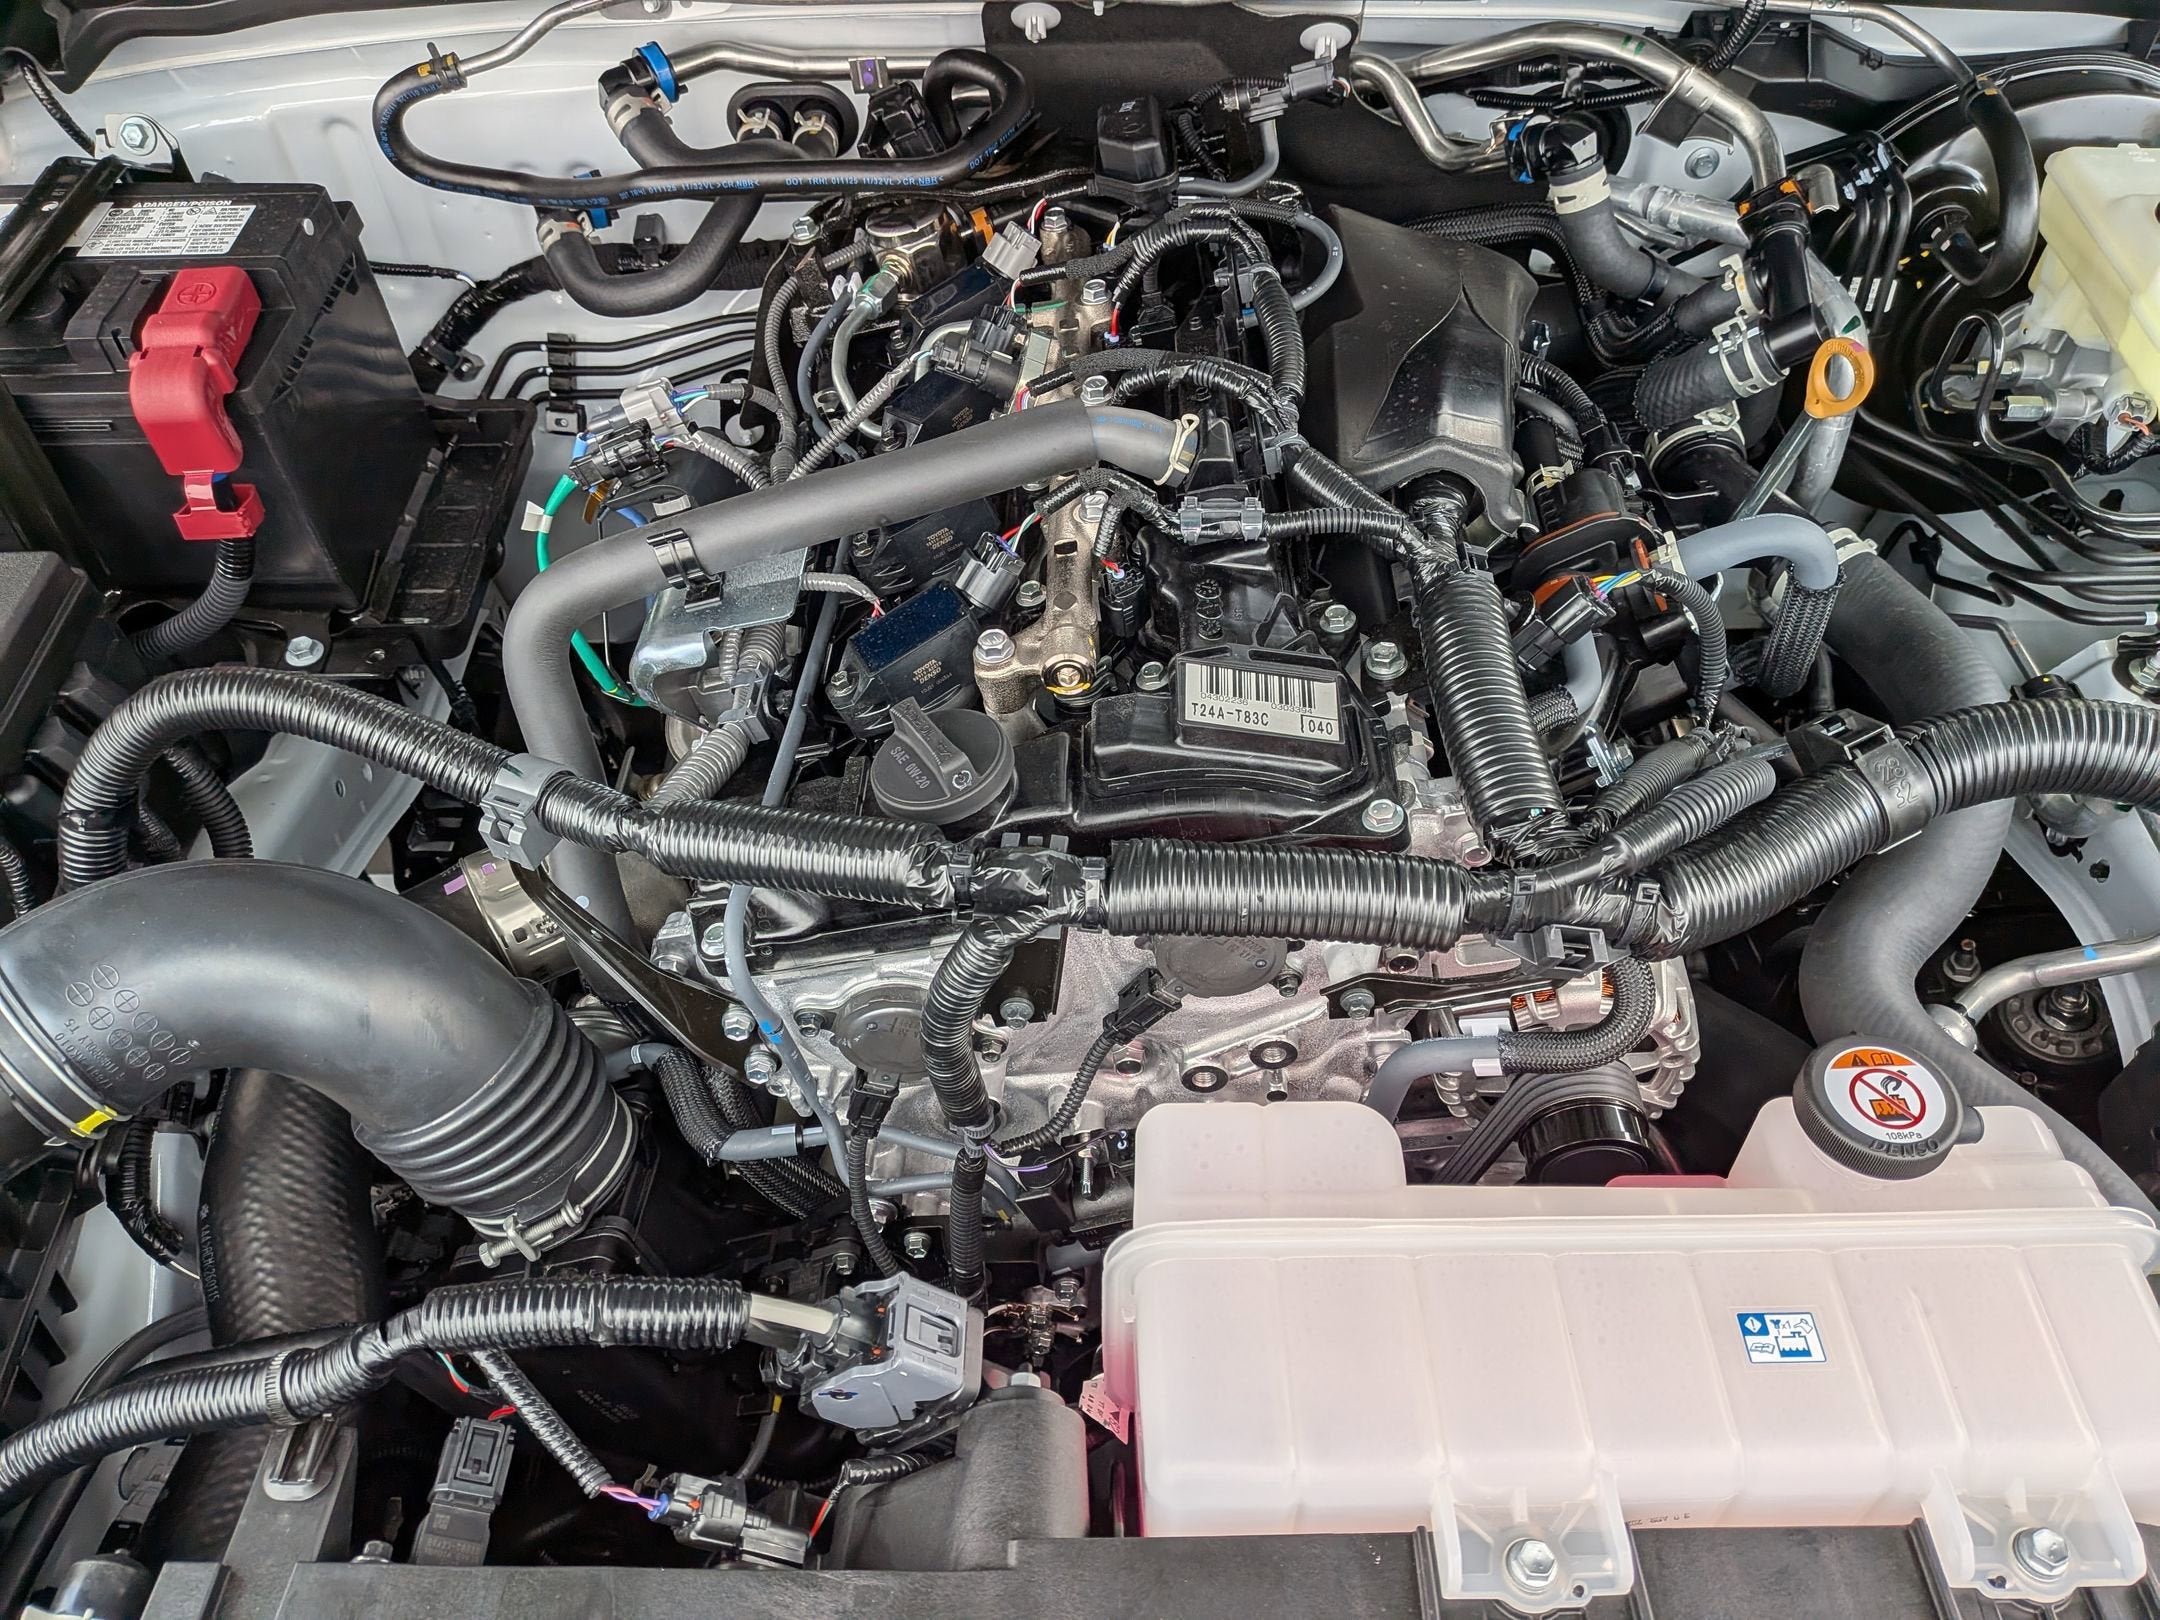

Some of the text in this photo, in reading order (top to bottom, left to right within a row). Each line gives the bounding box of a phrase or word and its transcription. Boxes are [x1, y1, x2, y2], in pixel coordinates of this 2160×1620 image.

[785, 177, 803, 186] DOT
[143, 200, 233, 208] DANGER/POISON
[927, 527, 950, 541] TOYOTA
[913, 659, 938, 675] TOYOTA
[920, 667, 942, 684] DENSO
[1200, 692, 1249, 706] 04302236
[1191, 702, 1270, 727] T24A-T83C
[1308, 719, 1333, 736] 040
[890, 746, 910, 765] SAE
[904, 762, 931, 789] 0W-20
[1885, 1131, 1923, 1141] 108kPa
[1869, 1138, 1940, 1158] DENSO
